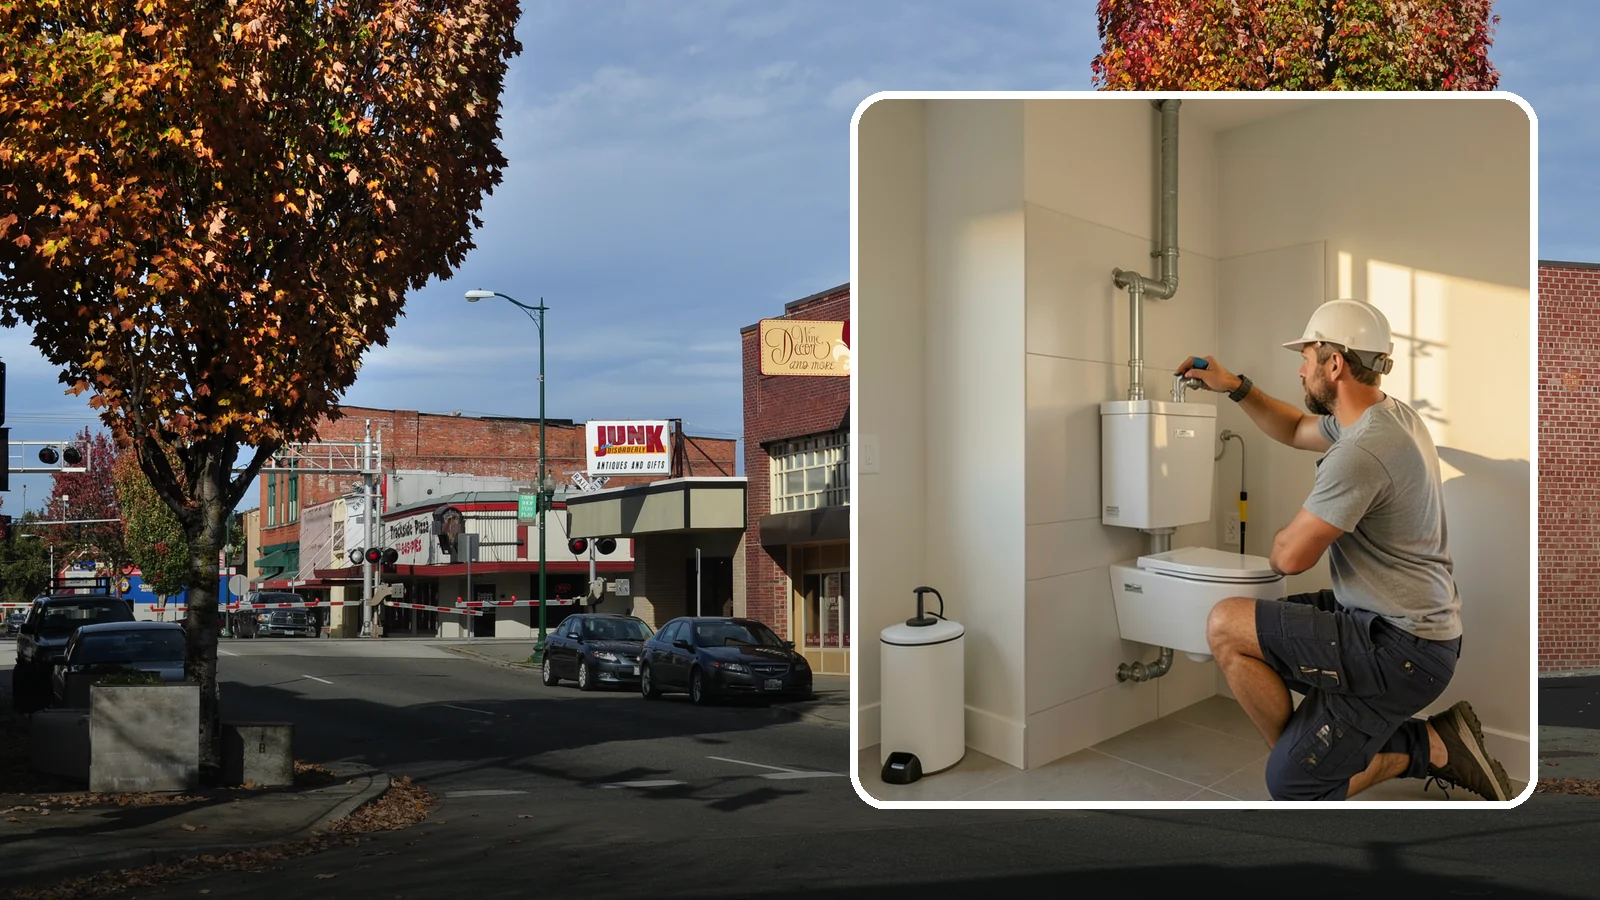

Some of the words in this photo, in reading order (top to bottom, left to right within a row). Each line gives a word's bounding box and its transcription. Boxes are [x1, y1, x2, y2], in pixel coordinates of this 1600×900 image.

[595, 425, 665, 457] JUNK
[607, 446, 645, 454] DISORDERLY
[597, 461, 628, 470] ANTIQUES
[631, 461, 644, 470] AND
[647, 460, 665, 469] GIFTS
[390, 521, 413, 539] Trackside
[414, 519, 429, 535] Pizza
